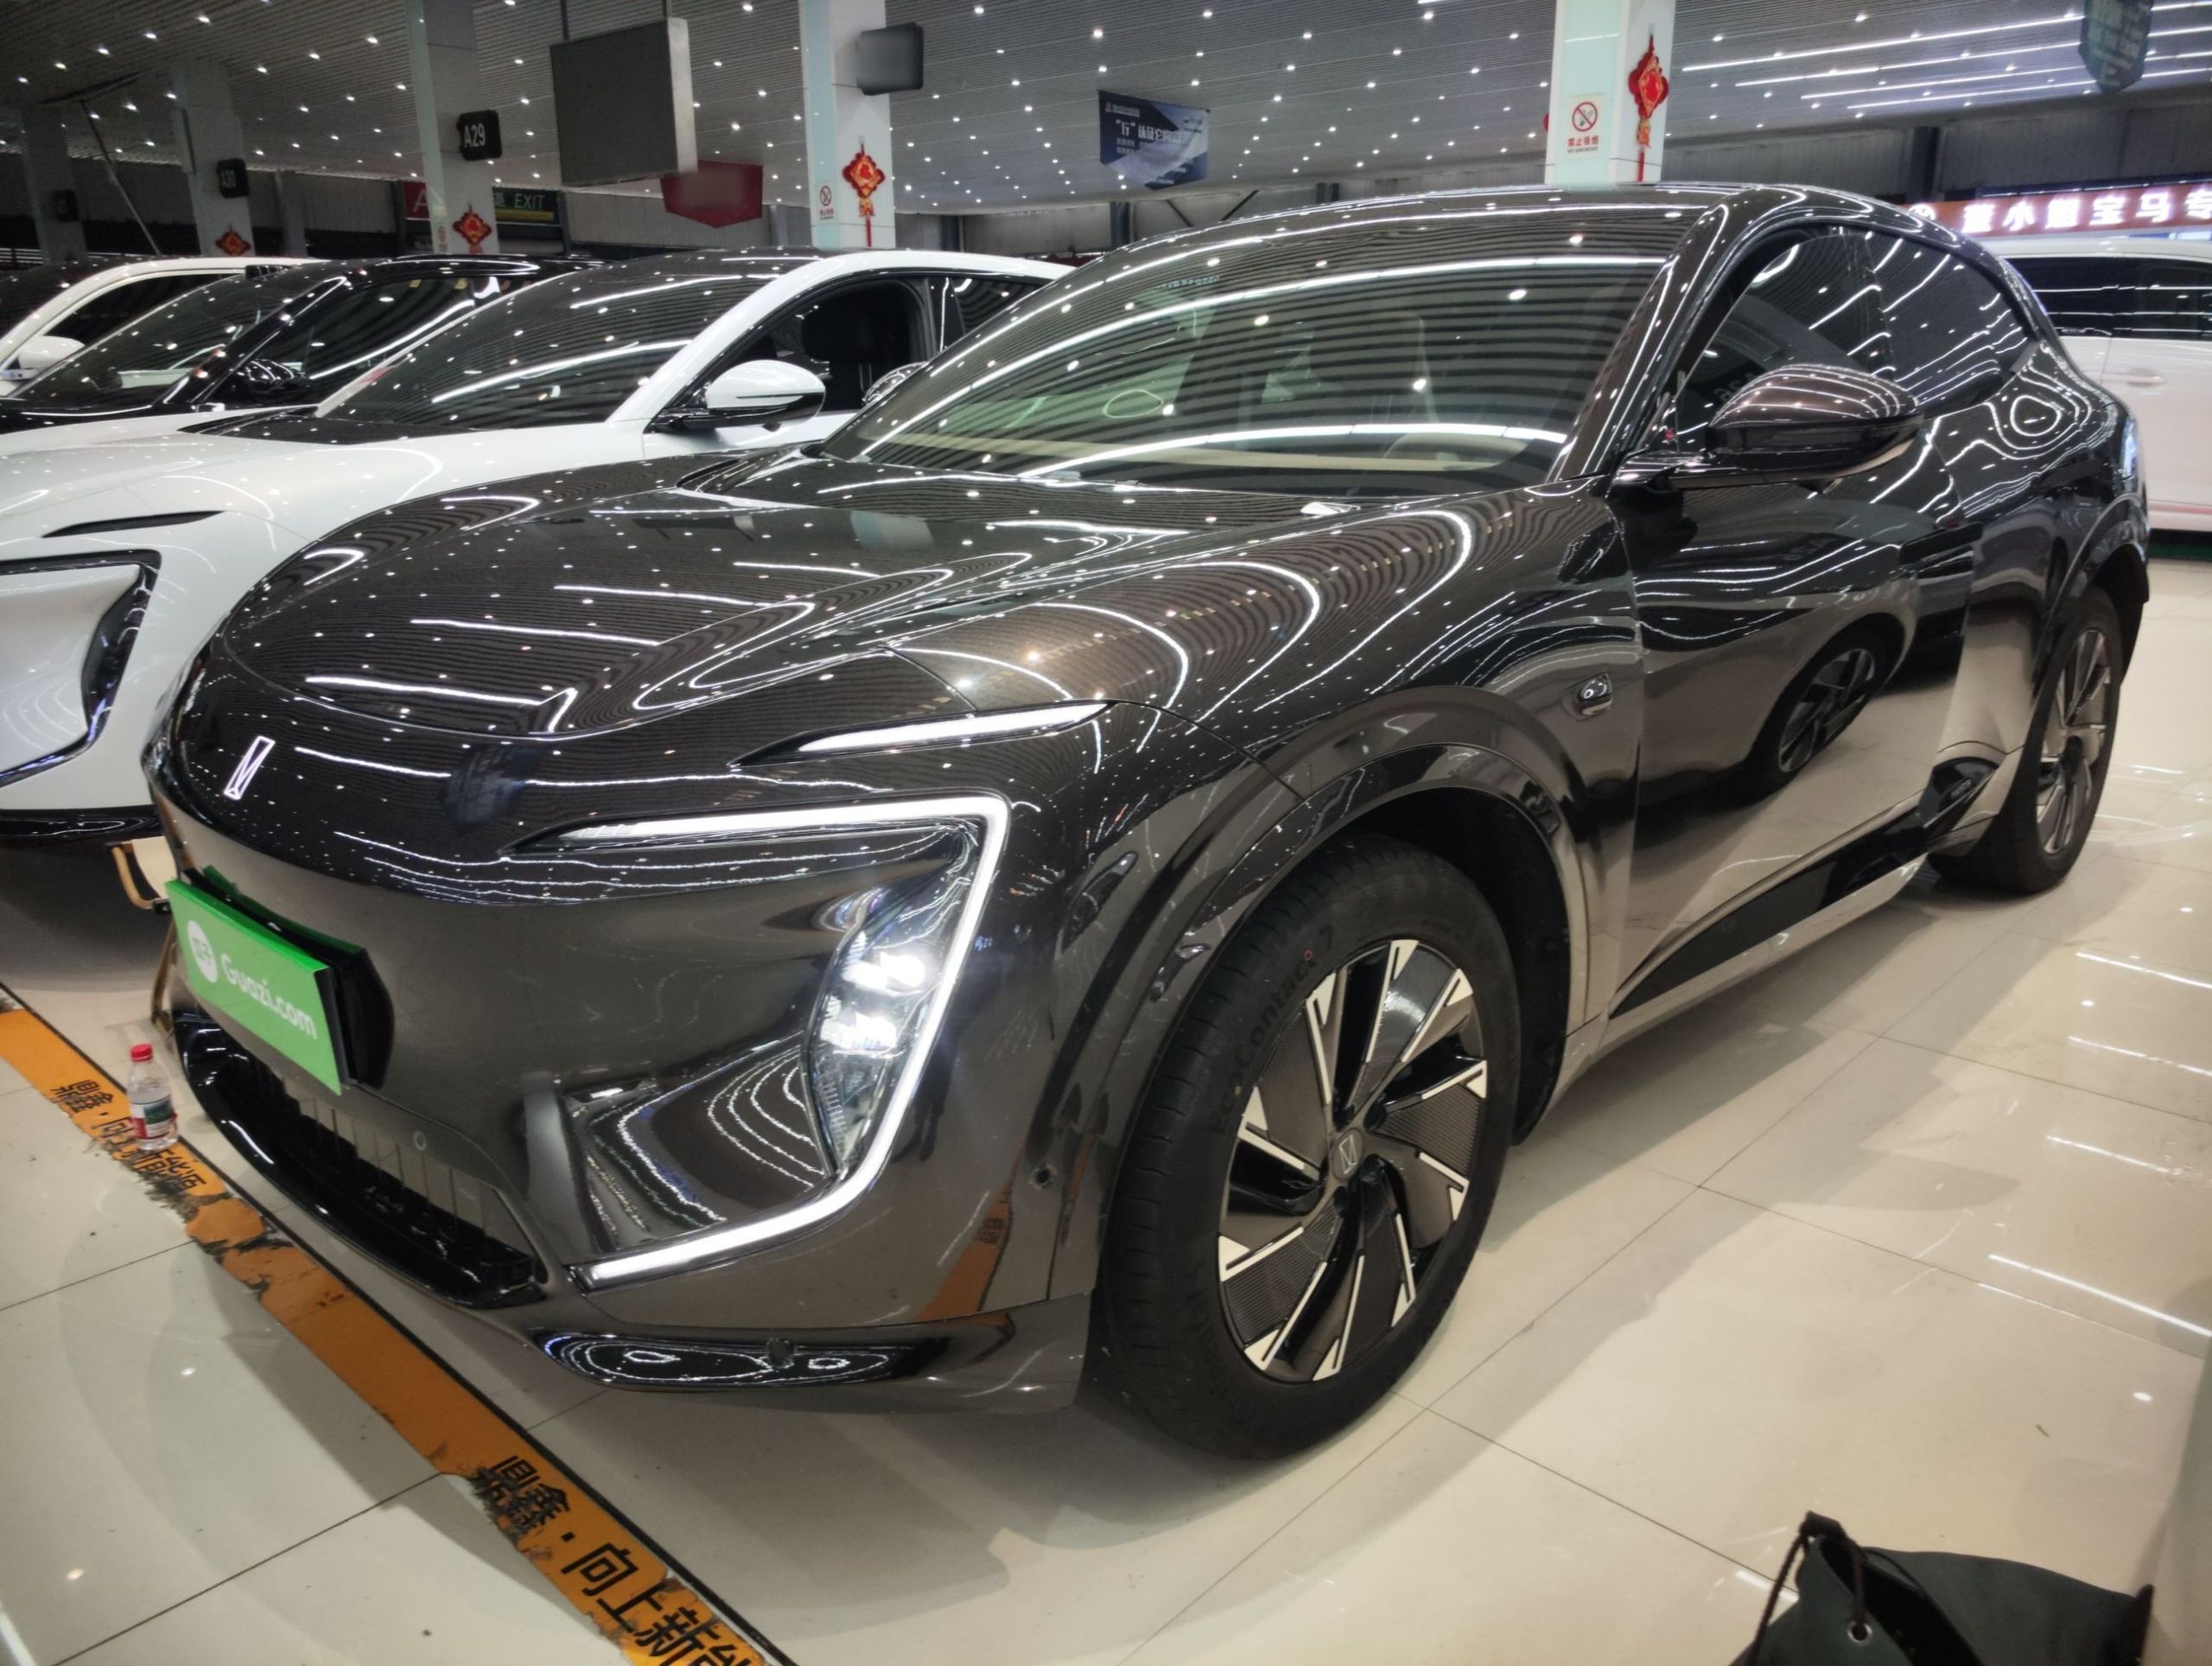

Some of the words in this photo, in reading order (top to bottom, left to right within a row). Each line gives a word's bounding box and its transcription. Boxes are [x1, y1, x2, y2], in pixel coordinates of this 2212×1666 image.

[464, 123, 486, 148] A29
[514, 193, 546, 209] EXIT
[221, 953, 317, 1040] Guazi.com
